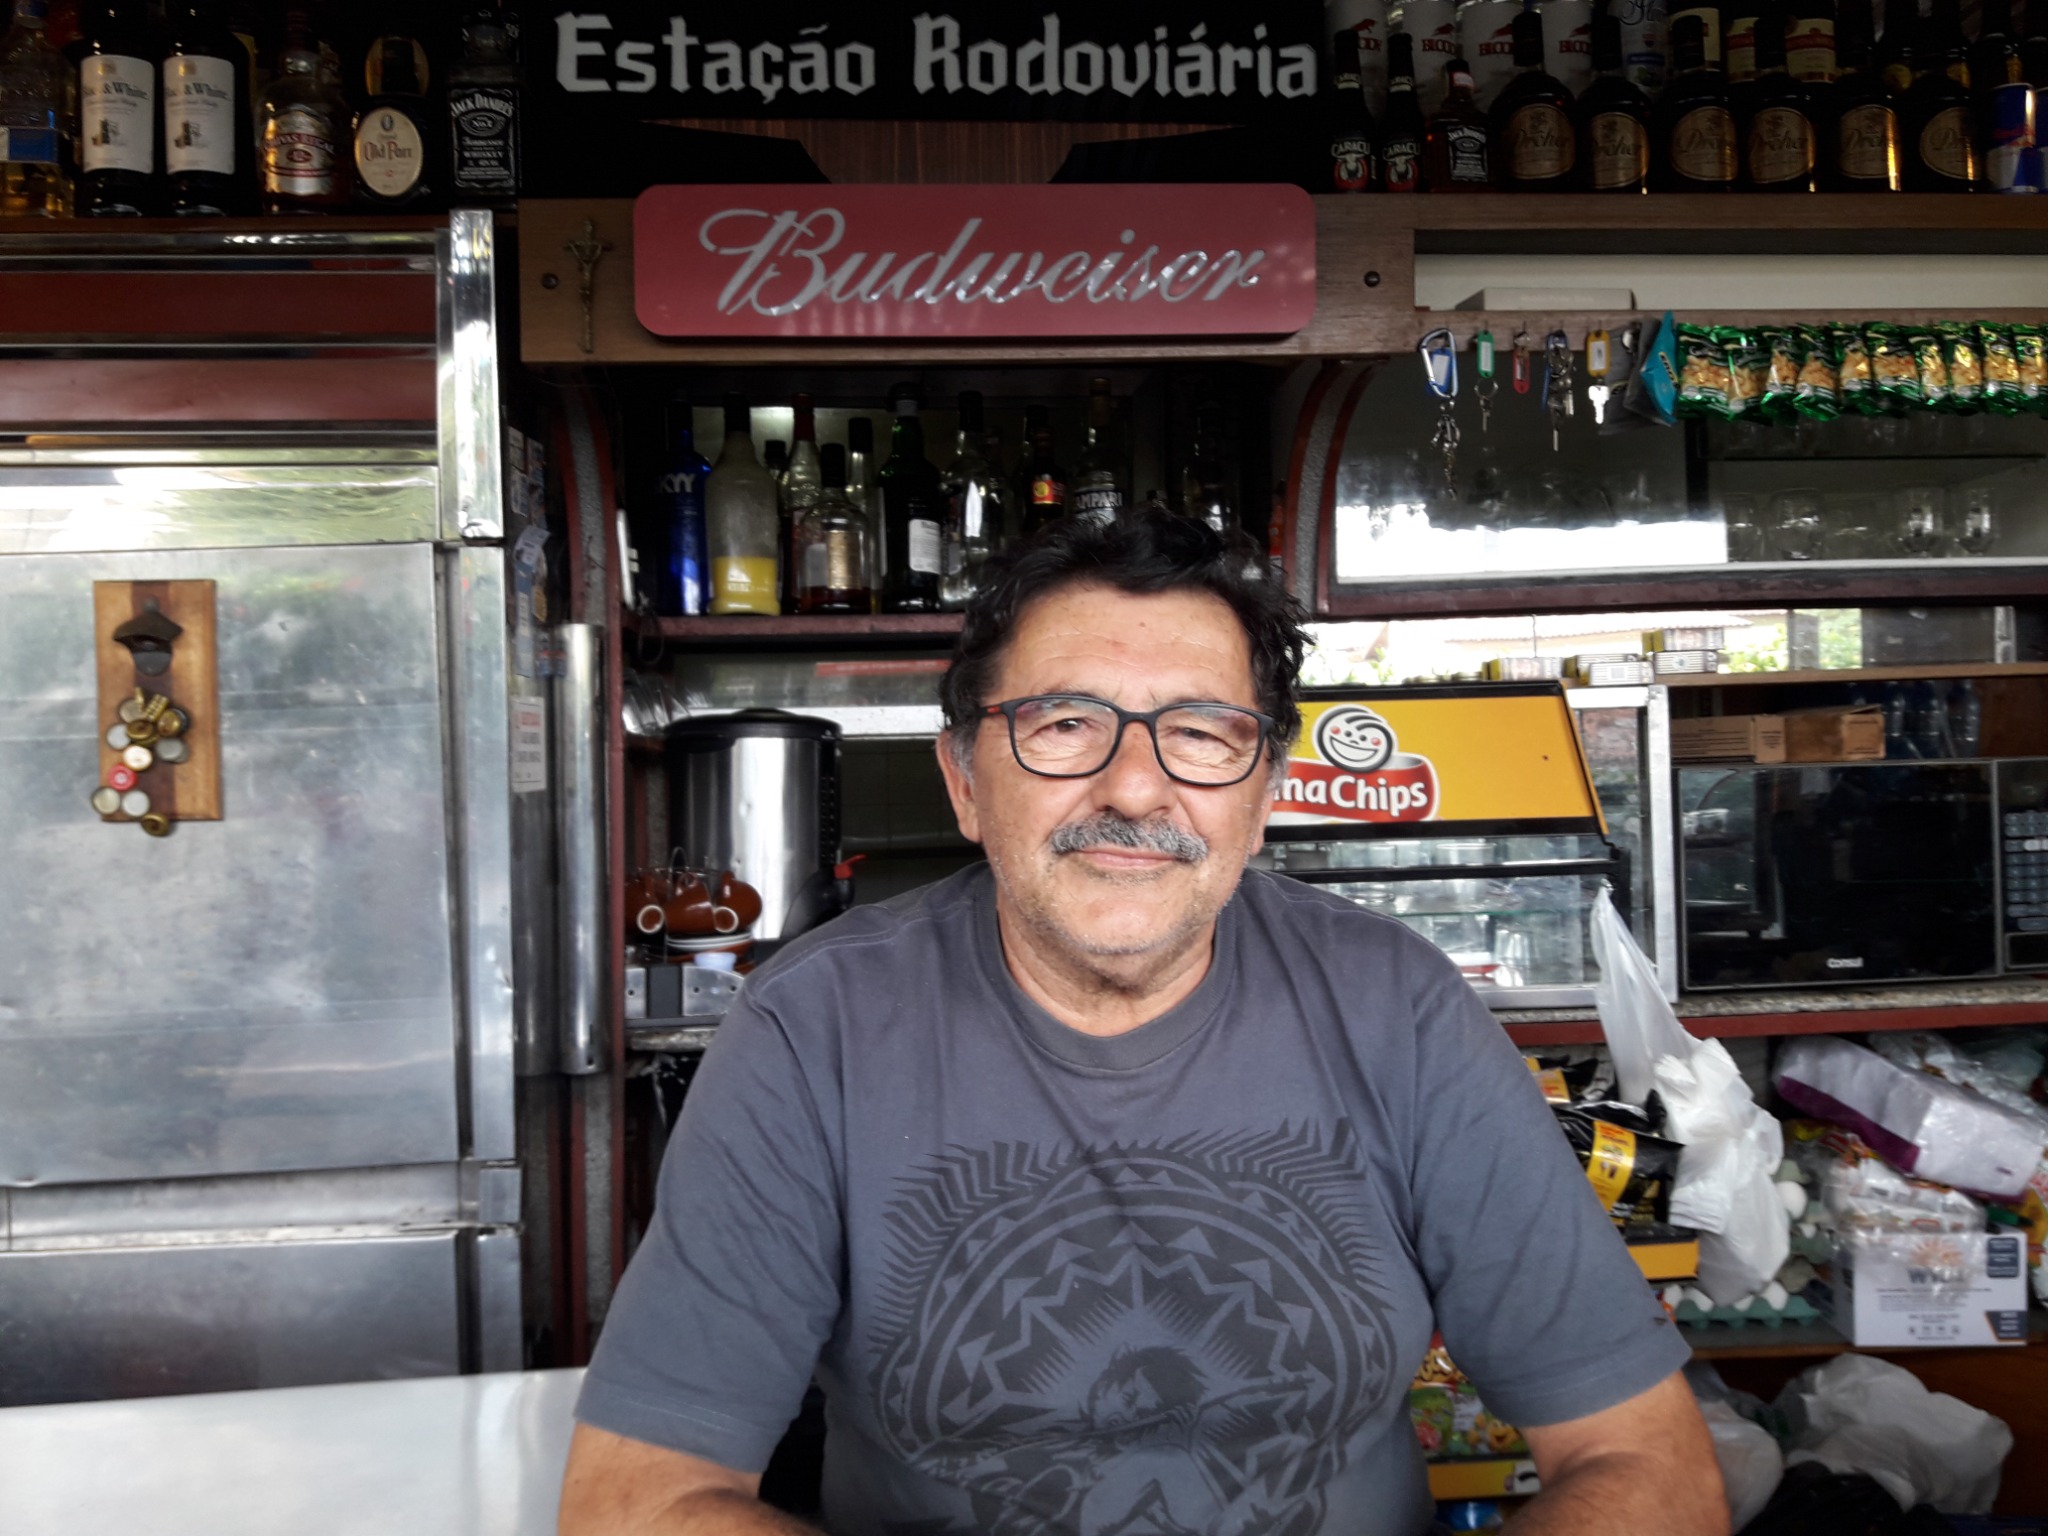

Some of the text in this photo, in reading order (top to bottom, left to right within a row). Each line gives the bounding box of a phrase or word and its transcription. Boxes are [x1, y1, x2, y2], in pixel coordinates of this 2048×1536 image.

[554, 11, 1319, 105] Estação Rodoviária
[1330, 141, 1371, 159] CARACU
[699, 206, 1268, 317] Budweiser
[1074, 491, 1124, 510] AMPARI
[1329, 774, 1428, 818] Chips
